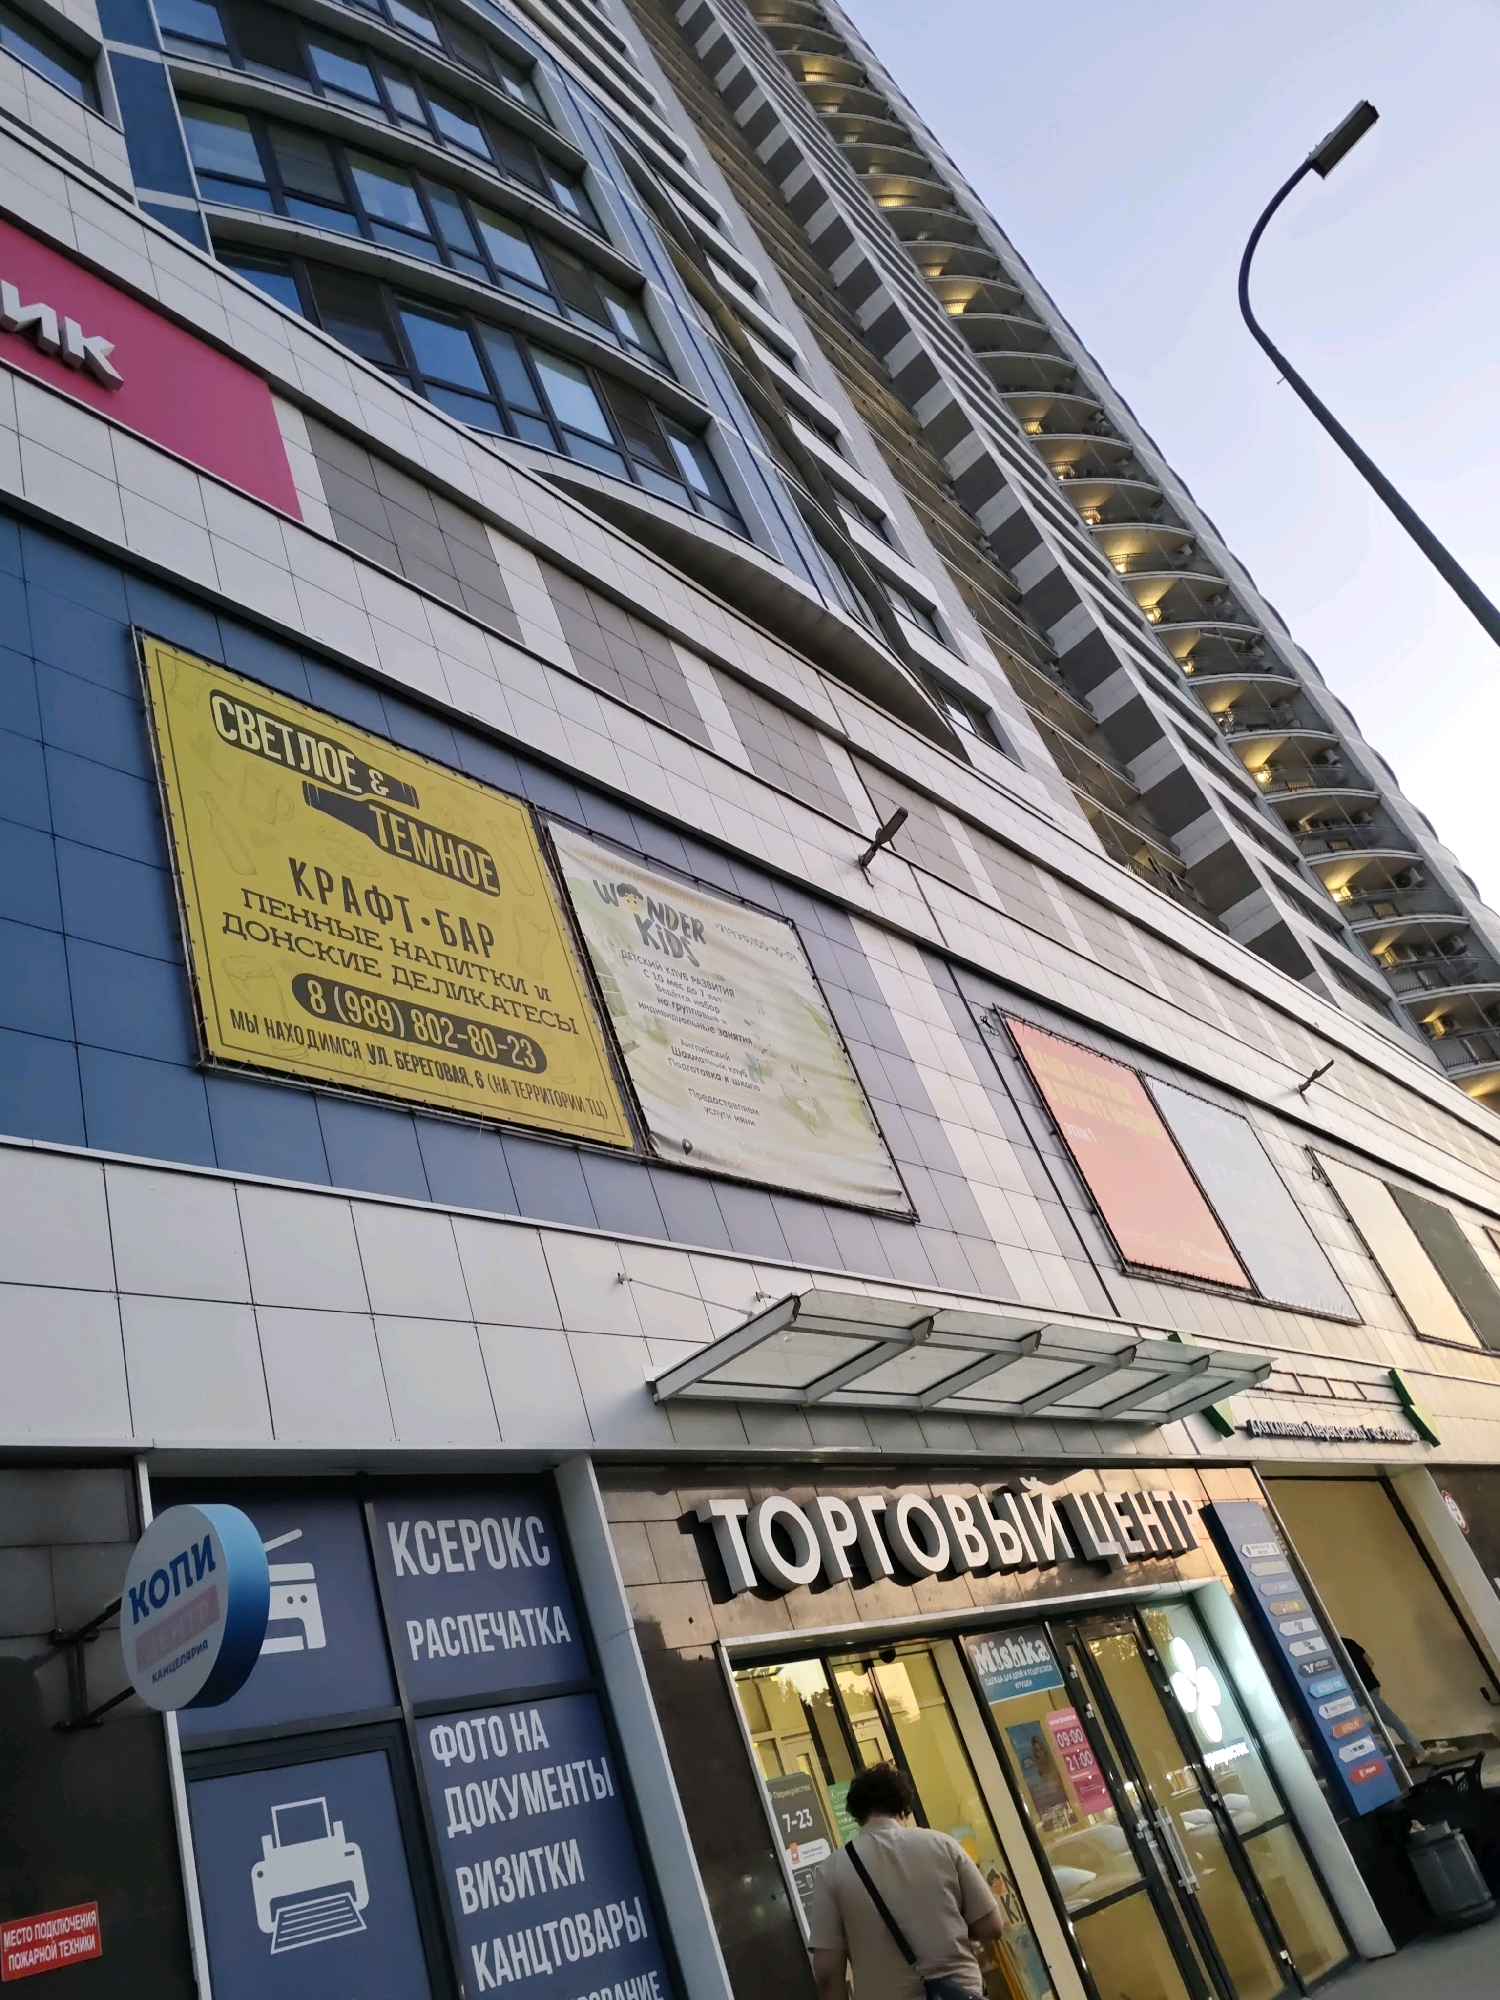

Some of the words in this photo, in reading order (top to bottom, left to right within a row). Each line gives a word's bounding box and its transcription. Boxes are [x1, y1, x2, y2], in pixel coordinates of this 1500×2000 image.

[212, 695, 362, 793] СВЕТЛОЕ
[368, 768, 389, 796] &
[369, 804, 499, 893] ТЕМНОЕ
[288, 857, 414, 933] КРАФТ
[435, 908, 494, 958] БАР
[240, 888, 383, 952] ПЕННЫЕ
[390, 936, 527, 996] НАПИТКИ
[222, 912, 381, 978] ДОНСКИЕ
[392, 965, 579, 1035] ДЕЛИКАТЕСЫ
[621, 949, 663, 972] ДЕТСКИЙ
[665, 965, 689, 982] КЛУБ
[690, 975, 735, 998] РАЗВИТИЯ
[652, 972, 664, 983] 10
[686, 986, 697, 996] до
[699, 988, 705, 997] 7
[307, 979, 327, 1014] 8
[333, 985, 405, 1037] (989)
[411, 1009, 536, 1069] 802-80-23
[637, 1001, 715, 1035] индивидуальные
[657, 997, 669, 1007] на
[671, 1002, 719, 1024] групповые
[694, 1000, 720, 1018] набор
[230, 1008, 259, 1033] МЫ
[264, 1016, 362, 1061] НАХОДИМСЯ
[366, 1042, 392, 1067] УЛ.
[395, 1051, 473, 1088] БЕРЕГОВАЯ,
[475, 1073, 485, 1090] 6
[488, 1074, 511, 1096] (НА
[511, 1080, 584, 1113] ТЕРРИТОРИИ
[586, 1098, 608, 1120] ТЦ)
[670, 1045, 727, 1071] Шахматный
[680, 1038, 731, 1062] Английский
[1025, 1046, 1076, 1083] ВАШИ
[667, 1057, 722, 1081] Подготовка
[731, 1078, 761, 1092] школе
[688, 1087, 761, 1117] Предоставляем
[703, 1105, 733, 1122] услуги
[734, 1114, 757, 1127] няни
[387, 1516, 550, 1577] КСЕРОКС
[704, 1477, 1074, 1593] ТОРГОВЫЙ
[1074, 1490, 1202, 1565] ЦЕНТР
[129, 1534, 216, 1625] КОПИ
[406, 1605, 571, 1661] РАСПЕЧАТКА
[969, 1635, 1050, 1675] Mishka
[151, 1639, 209, 1684] КАНЦЕЛЯРИЯ
[429, 1715, 508, 1768] ФОТО
[509, 1708, 550, 1754] НА
[1056, 1728, 1084, 1748] 09:00
[1066, 1750, 1093, 1771] 21:00
[444, 1756, 615, 1839] ДОКУМЕНТЫ
[782, 1808, 813, 1833] 7-23
[455, 1838, 585, 1915] ВИЗИТКИ
[3, 1926, 33, 1949] МЕСТО
[34, 1910, 97, 1941] ПОДКЛЮЧЕНИЯ
[470, 1896, 648, 1993] КАНЦТОВАРЫ
[8, 1940, 57, 1972] ПОЖАРНОЙ
[59, 1934, 95, 1958] ТЕХНИКИ
